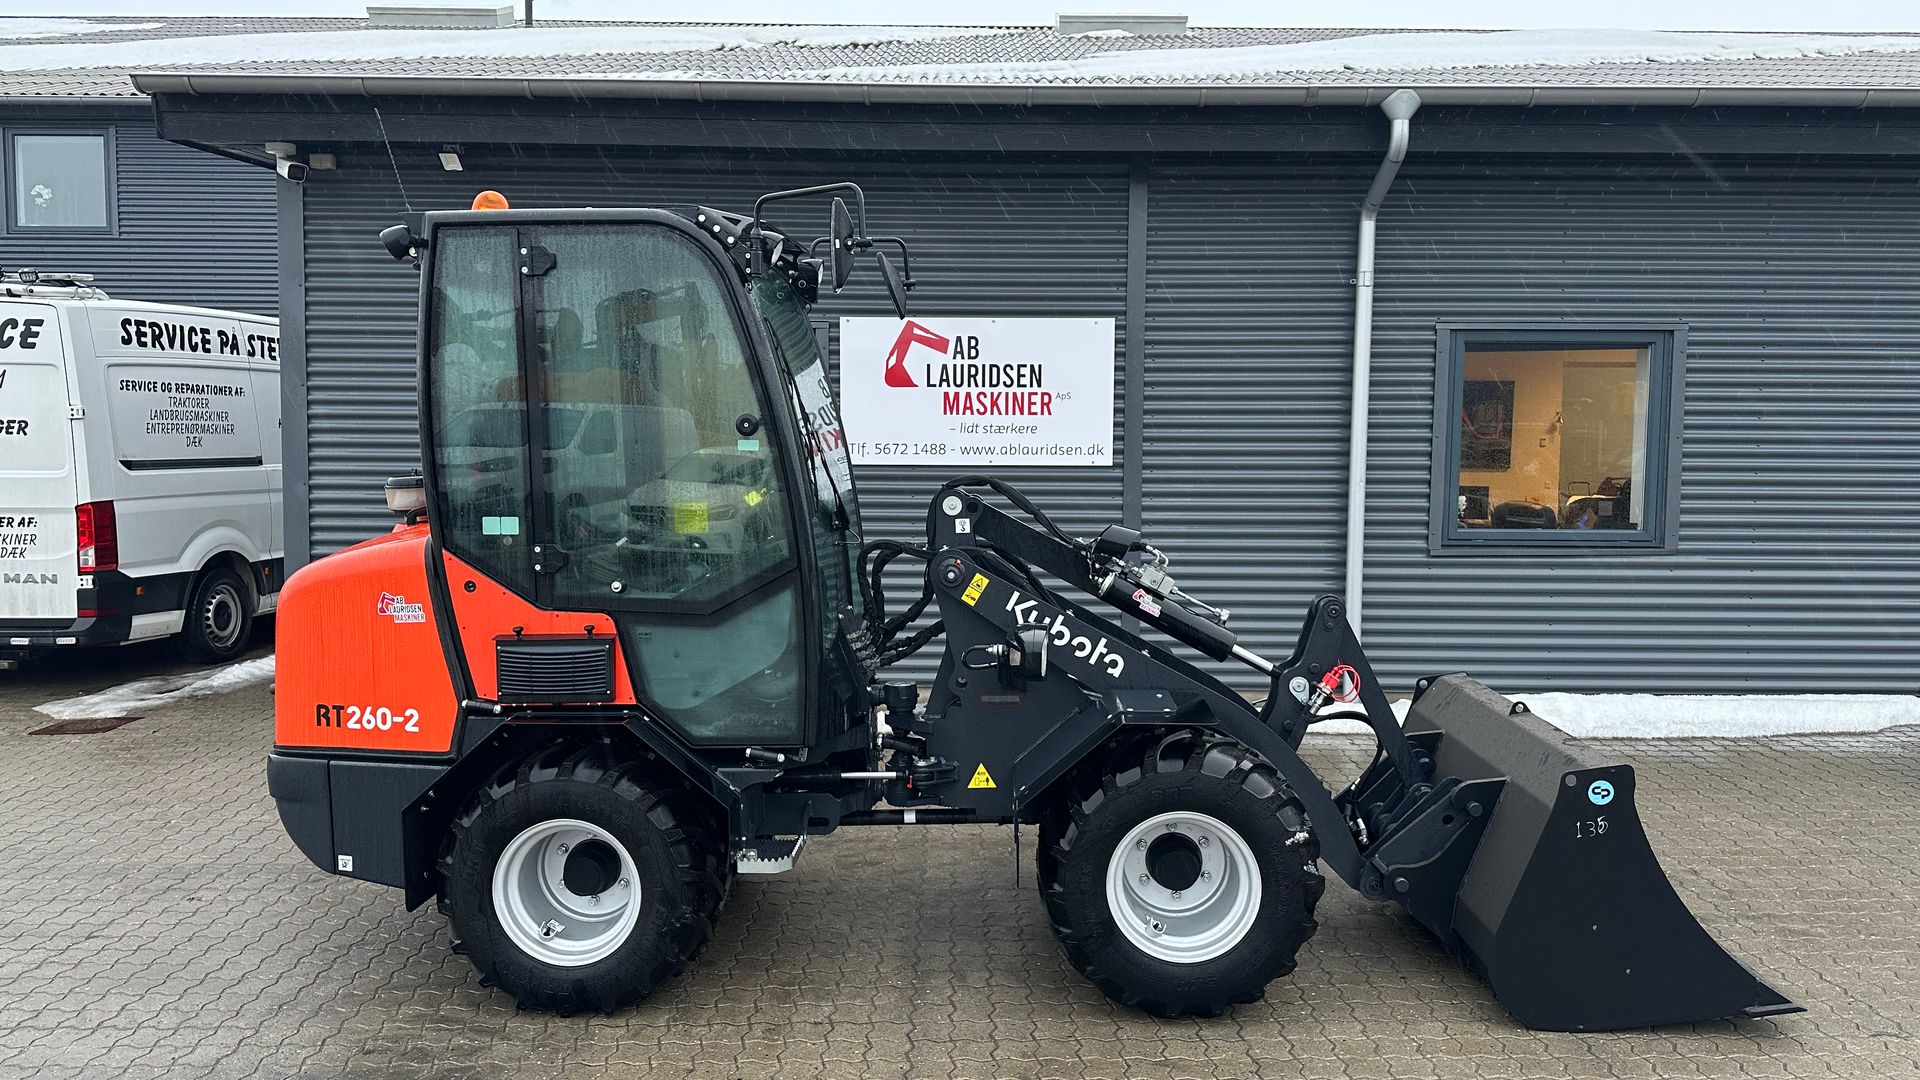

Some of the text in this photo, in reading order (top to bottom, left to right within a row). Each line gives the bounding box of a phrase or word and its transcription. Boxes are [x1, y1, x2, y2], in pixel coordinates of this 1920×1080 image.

[120, 317, 281, 361] SERVICE PÅ STE
[952, 335, 980, 360] AB
[926, 363, 1043, 388] LAURIDSEN
[119, 378, 246, 397] SERVICE OG REPARATIONER AF:
[168, 396, 210, 409] TRAKTORER
[942, 391, 1072, 416] MASKINER ApS
[149, 409, 230, 422] LANDBRUGSMASKINER
[145, 422, 236, 435] ENTREPRENØRMASKINER
[959, 422, 980, 434] lidt
[982, 422, 1039, 435] stærkere
[186, 436, 204, 448] DÆK
[848, 442, 870, 457] Tlf.
[874, 443, 909, 456] 5672
[912, 443, 947, 456] 1488
[959, 441, 1105, 457] www.ablauridsen.dk
[17, 516, 38, 528] AF:
[0, 547, 27, 559] DÆK
[4, 573, 58, 585] MAN
[395, 596, 404, 605] AB
[388, 604, 422, 614] LAURIDSEN
[394, 613, 425, 622] MASKINER
[315, 703, 421, 733] RT260-2
